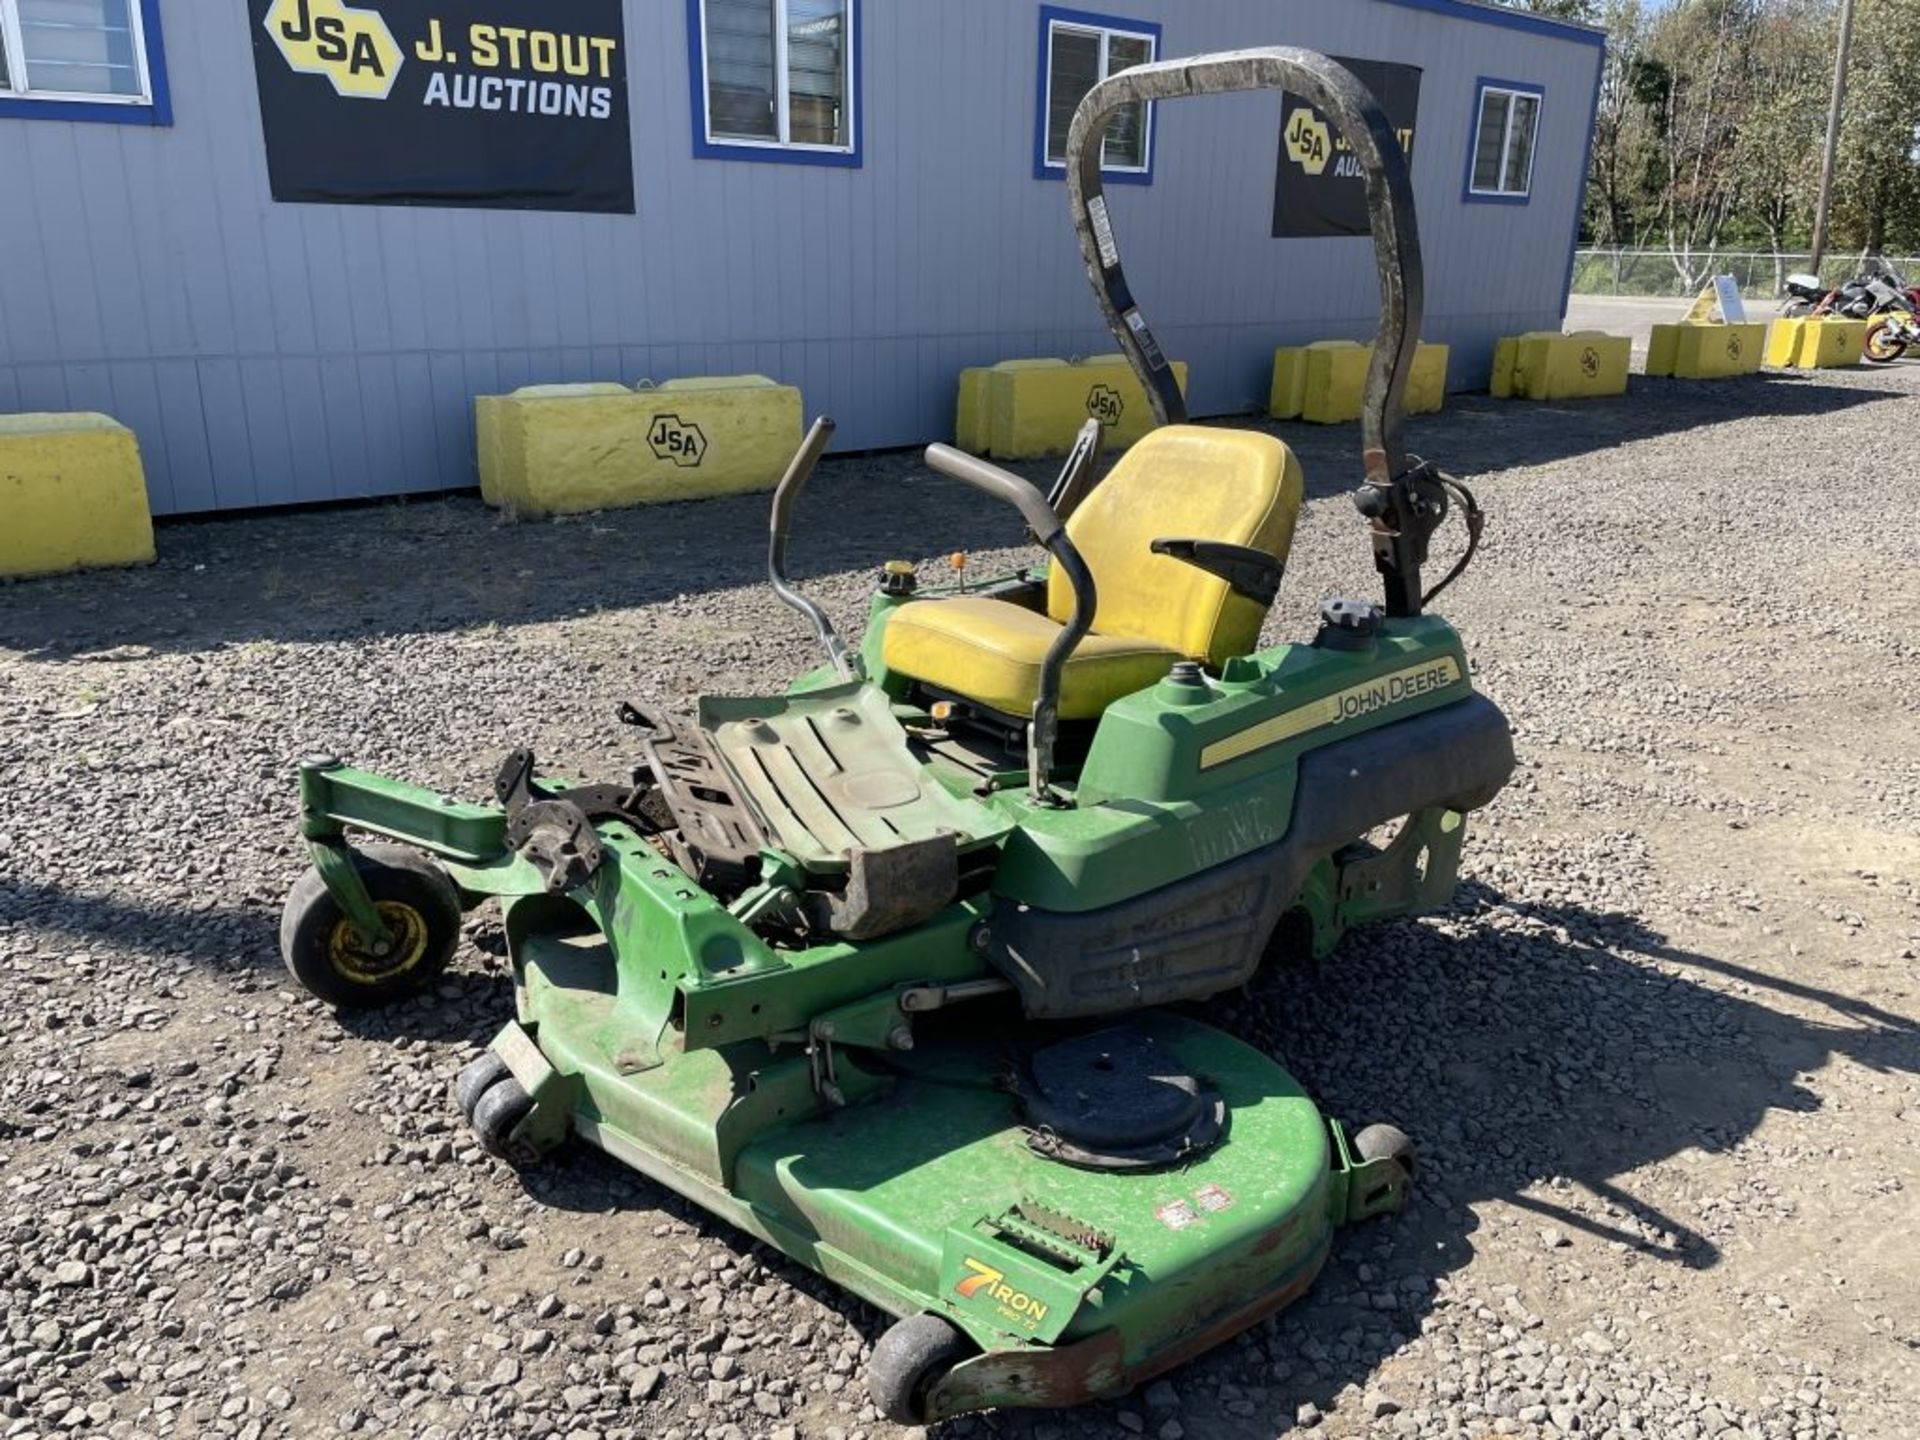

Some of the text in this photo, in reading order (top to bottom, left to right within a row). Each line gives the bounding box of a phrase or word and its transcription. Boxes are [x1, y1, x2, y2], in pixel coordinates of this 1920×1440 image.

[280, 0, 385, 78] JSA
[415, 19, 616, 78] J. STOUT
[423, 72, 611, 119] AUCTIONS
[1289, 117, 1323, 162] JSA
[1091, 391, 1117, 417] JSA
[653, 423, 698, 456] JSA
[1333, 664, 1450, 722] JOHN DEERE
